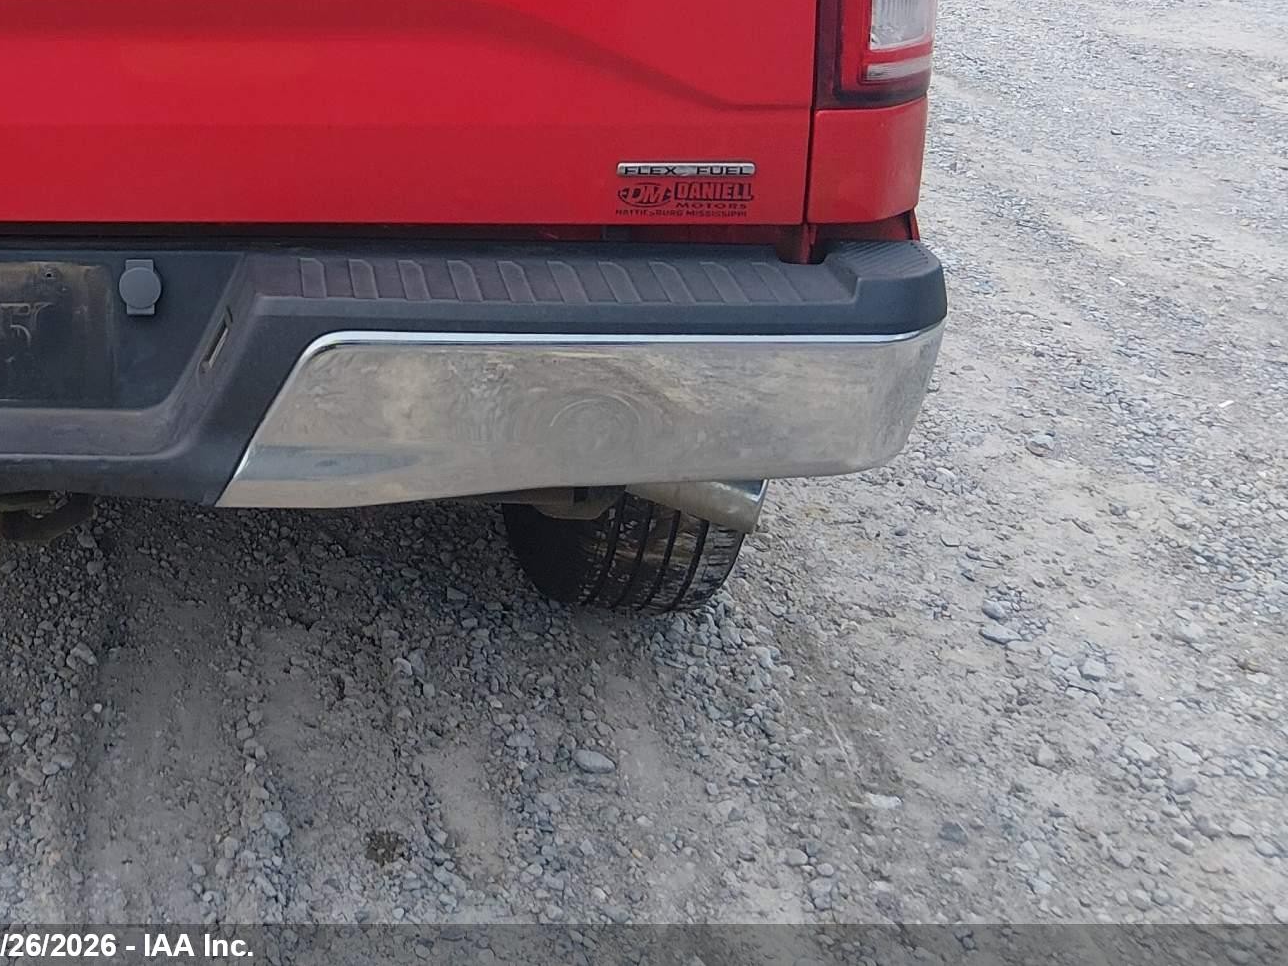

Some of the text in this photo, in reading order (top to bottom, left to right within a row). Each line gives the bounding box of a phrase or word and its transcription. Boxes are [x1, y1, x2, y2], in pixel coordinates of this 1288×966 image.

[623, 166, 751, 176] FLEX FUEL
[673, 181, 755, 202] DANIELL
